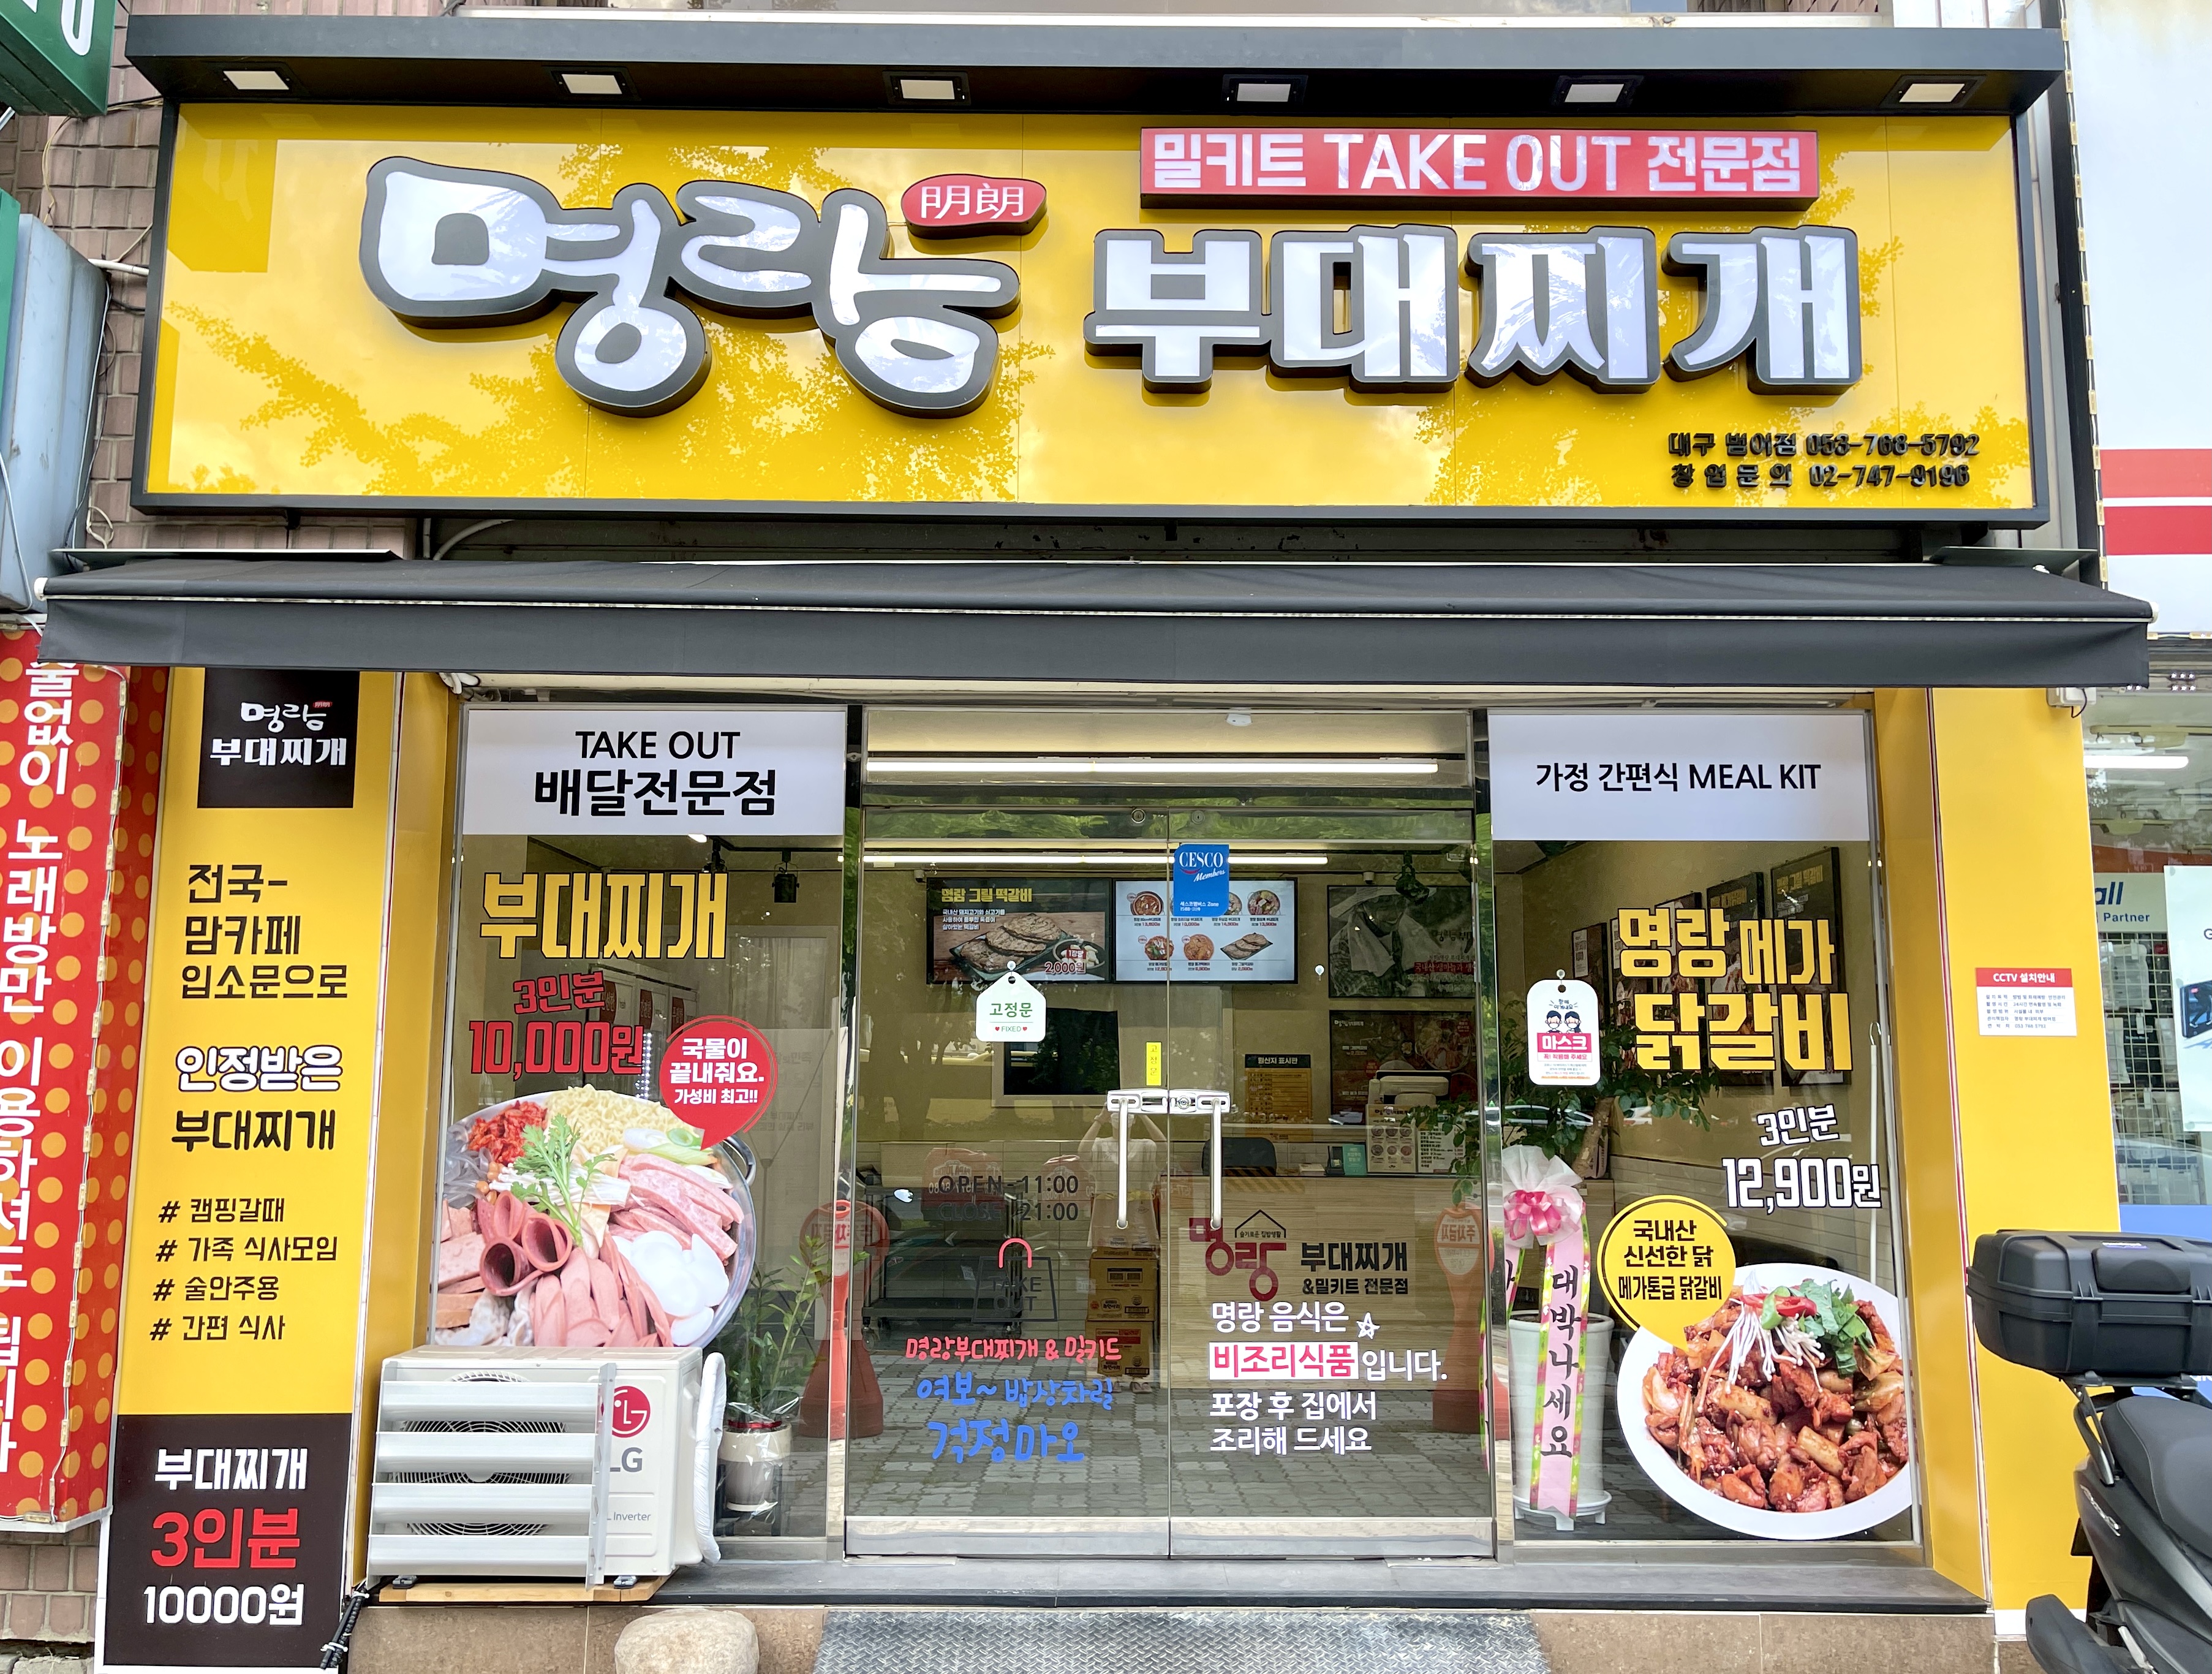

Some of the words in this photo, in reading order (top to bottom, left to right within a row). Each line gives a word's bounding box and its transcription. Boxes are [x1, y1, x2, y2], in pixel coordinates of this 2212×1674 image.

[1152, 133, 1307, 188] 밀키트
[1324, 134, 1485, 191] TAKE
[1506, 134, 1631, 191] OUT
[1647, 133, 1801, 191] 전문점
[920, 184, 1024, 220] 明朗
[361, 157, 1018, 412] 명랑
[1087, 225, 1857, 389] 부대찌개
[1668, 433, 1716, 456] 대구
[1726, 433, 1797, 456] 범어점
[1806, 433, 1980, 456] 053-768-5792
[1809, 464, 1970, 488] 02-747-9196
[241, 702, 327, 733] 명랑
[210, 737, 346, 766] 부대찌개
[575, 731, 657, 759] TAKE
[668, 731, 741, 759] OUT
[1536, 763, 1588, 792] 가정
[1599, 763, 1678, 792] 간편식
[1689, 764, 1772, 789] MEAL
[1780, 764, 1821, 789] KIT
[534, 769, 776, 816] 배달전문점
[1179, 852, 1223, 868] CESCO
[1193, 868, 1226, 882] Members
[969, 888, 992, 902] 그릴
[996, 888, 1032, 902] 떡갈비
[0, 819, 62, 1013] 노래방만
[480, 872, 729, 960] 부대찌개
[2104, 912, 2150, 922] Partner
[185, 915, 301, 955] 맘카페
[1618, 908, 1730, 978] 명랑
[1739, 919, 1836, 985] 메가
[182, 965, 347, 999] 입소문으로
[1045, 961, 1085, 974] 2,000원
[1414, 963, 1435, 972] 국내산
[1993, 973, 2017, 982] CCTV
[2020, 972, 2055, 983] 설치안내
[513, 970, 606, 1015] 3인분
[989, 1002, 1033, 1018] 고정문
[1542, 1035, 1587, 1050] 마스크
[1634, 993, 1853, 1071] 닭갈비
[469, 1020, 644, 1081] 10,000원
[682, 1037, 747, 1059] 국물이
[175, 1045, 342, 1092] 인정받은
[670, 1062, 764, 1084] 끝내줘요.
[674, 1089, 716, 1104] 가성비
[720, 1088, 758, 1104] 최고!!
[172, 1110, 335, 1151] 부대찌개
[1756, 1104, 1840, 1146] 3인분
[938, 1175, 1002, 1194] OPEN
[1021, 1175, 1078, 1194] 11:00
[1722, 1157, 1882, 1214] 12,900원
[191, 1198, 285, 1222] 캠핑갈때
[938, 1202, 1002, 1221] CLOSE
[1021, 1202, 1078, 1221] 21:00
[1634, 1220, 1696, 1241] 국내산
[188, 1237, 234, 1262] 가족
[244, 1237, 338, 1262] 식사모임
[1301, 1241, 1408, 1271] 부대찌개
[1624, 1245, 1688, 1267] 신선한
[1693, 1245, 1713, 1267] 닭
[185, 1276, 279, 1301] 술안주용
[989, 1277, 1042, 1292] TAKE
[1364, 1278, 1408, 1295] 전문점
[1618, 1276, 1674, 1300] 메가톤급
[1680, 1276, 1722, 1300] 닭갈비
[994, 1297, 1036, 1311] OUT
[1212, 1301, 1264, 1333] 명랑
[1269, 1301, 1349, 1333] 음식은
[183, 1315, 228, 1341] 간편
[239, 1315, 285, 1341] 식사
[905, 1336, 1038, 1362] 명랑부대찌개
[1045, 1339, 1059, 1360] &
[1214, 1345, 1356, 1377] 비조리식품
[1362, 1350, 1448, 1381] 입니다.
[1005, 1377, 1113, 1410] 밥상차릴
[1210, 1392, 1262, 1421] 포장
[1267, 1392, 1294, 1421] 후
[1301, 1392, 1376, 1421] 집에서
[928, 1418, 1084, 1463] 걱정마오
[1210, 1426, 1286, 1455] 조리해
[1294, 1427, 1372, 1455] 드세요
[154, 1449, 308, 1490] 부대찌개
[613, 1511, 651, 1521] Inverter
[151, 1508, 300, 1569] 3인분
[143, 1583, 304, 1626] 10000원
